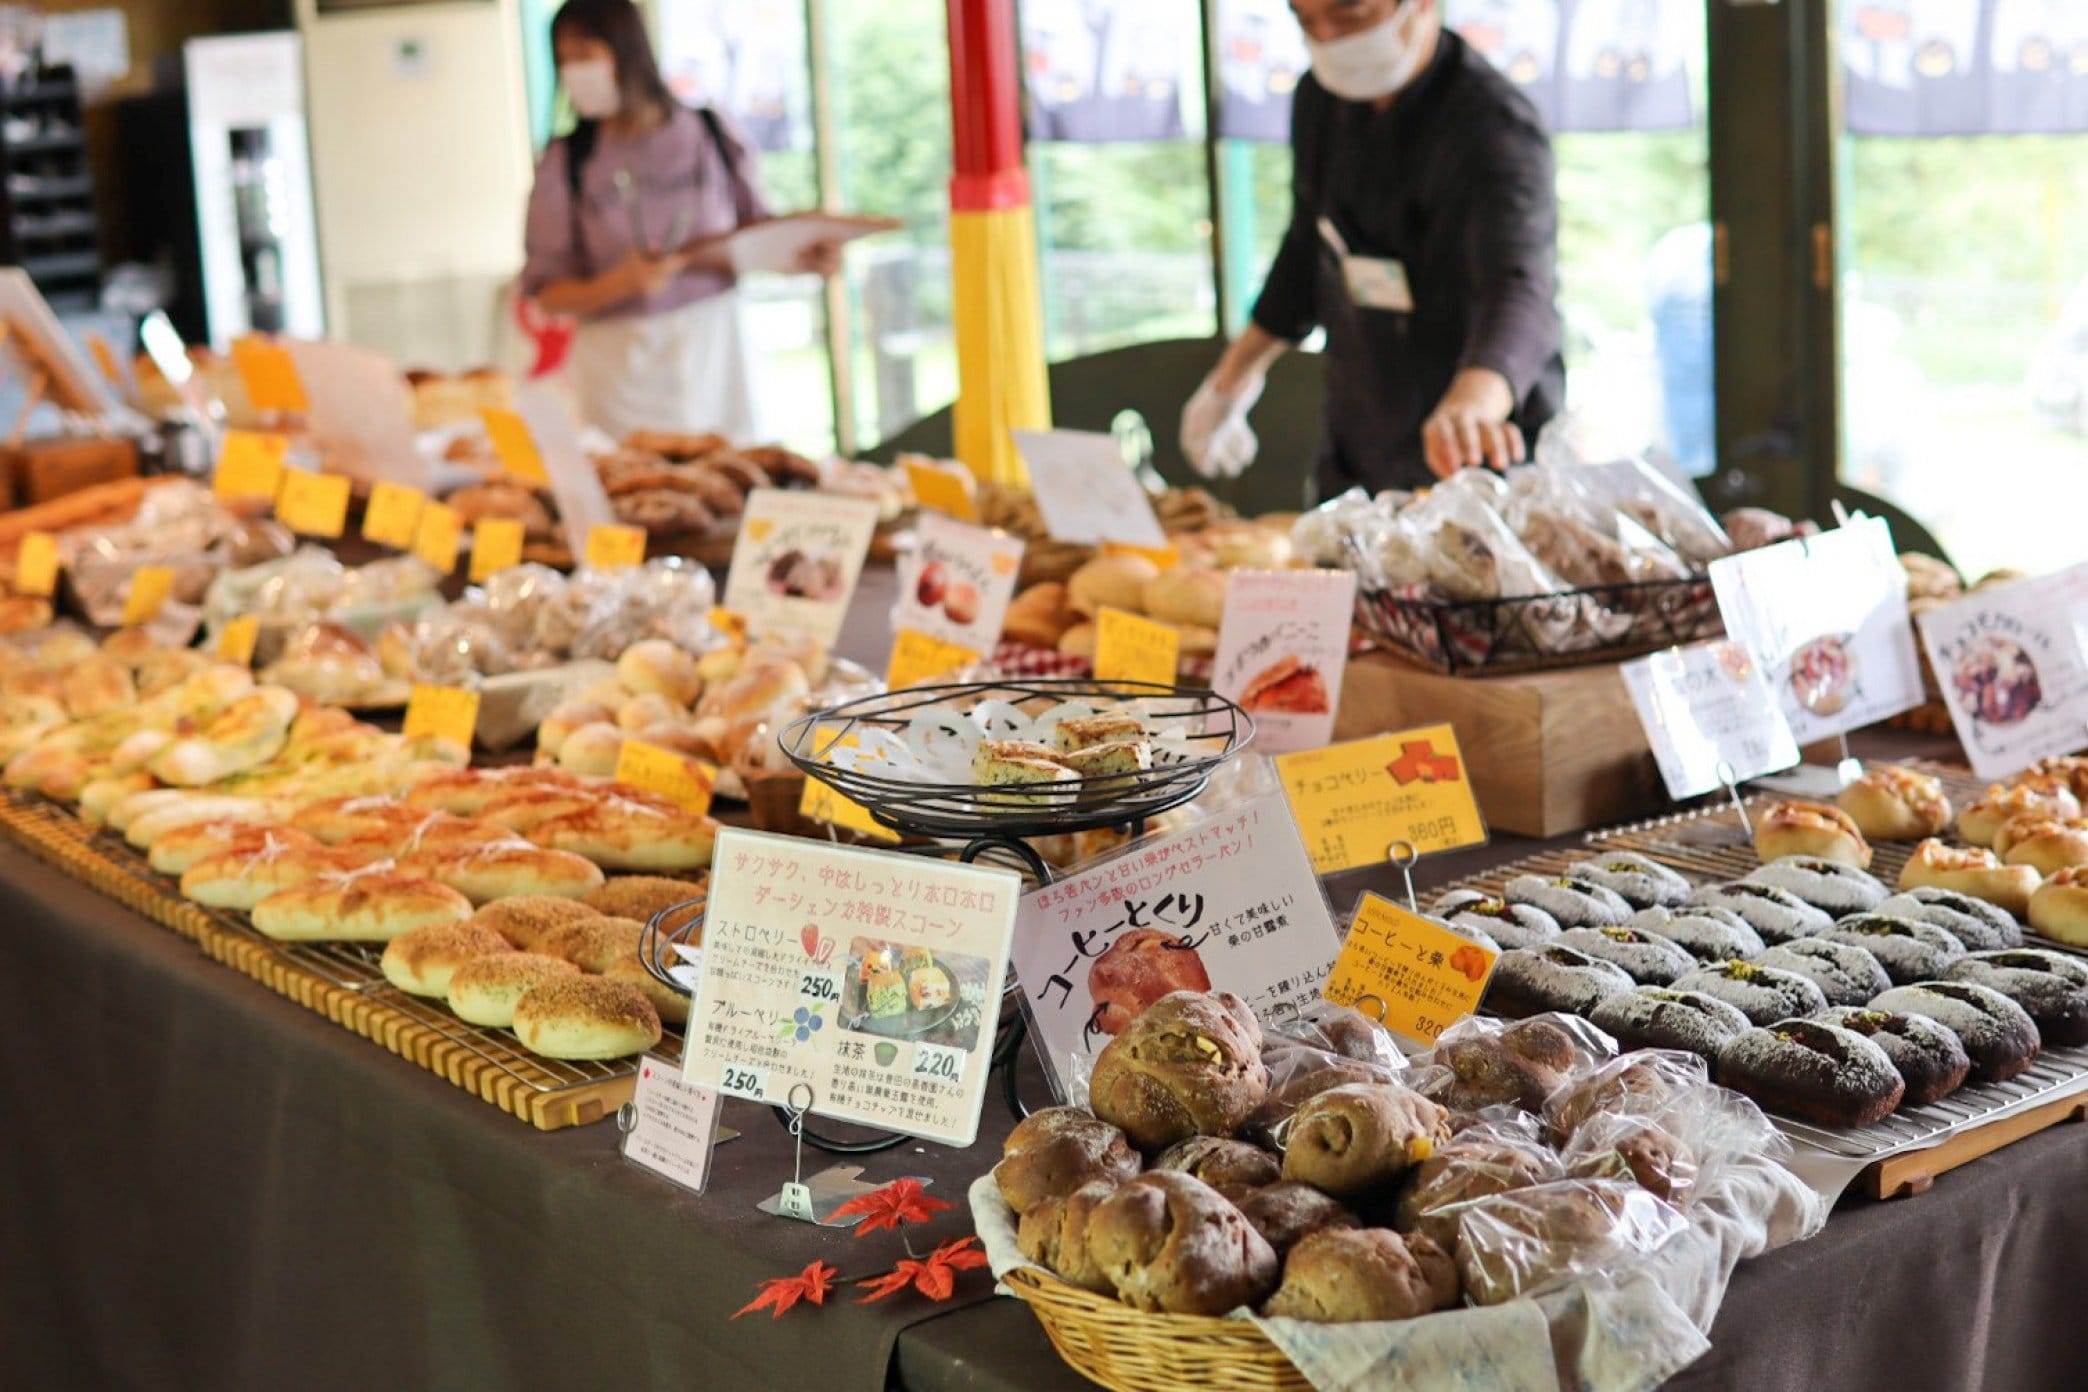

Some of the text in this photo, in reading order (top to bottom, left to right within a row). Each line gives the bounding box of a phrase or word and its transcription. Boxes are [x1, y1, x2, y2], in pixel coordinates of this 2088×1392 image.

[1408, 815, 1457, 842] 360円
[755, 885, 964, 936] ダーシェンカ特製スコーン
[1209, 894, 1295, 937] 甘くて美味しい
[718, 920, 798, 945] ストロベリー
[1228, 914, 1289, 948] 栗の甘露煮
[1354, 918, 1445, 970] コーヒーと栗
[800, 976, 840, 1003] 250円
[1416, 1016, 1444, 1039] 320
[837, 1040, 866, 1060] 抹茶
[914, 1050, 960, 1083] 220円
[722, 1068, 763, 1098] 250円
